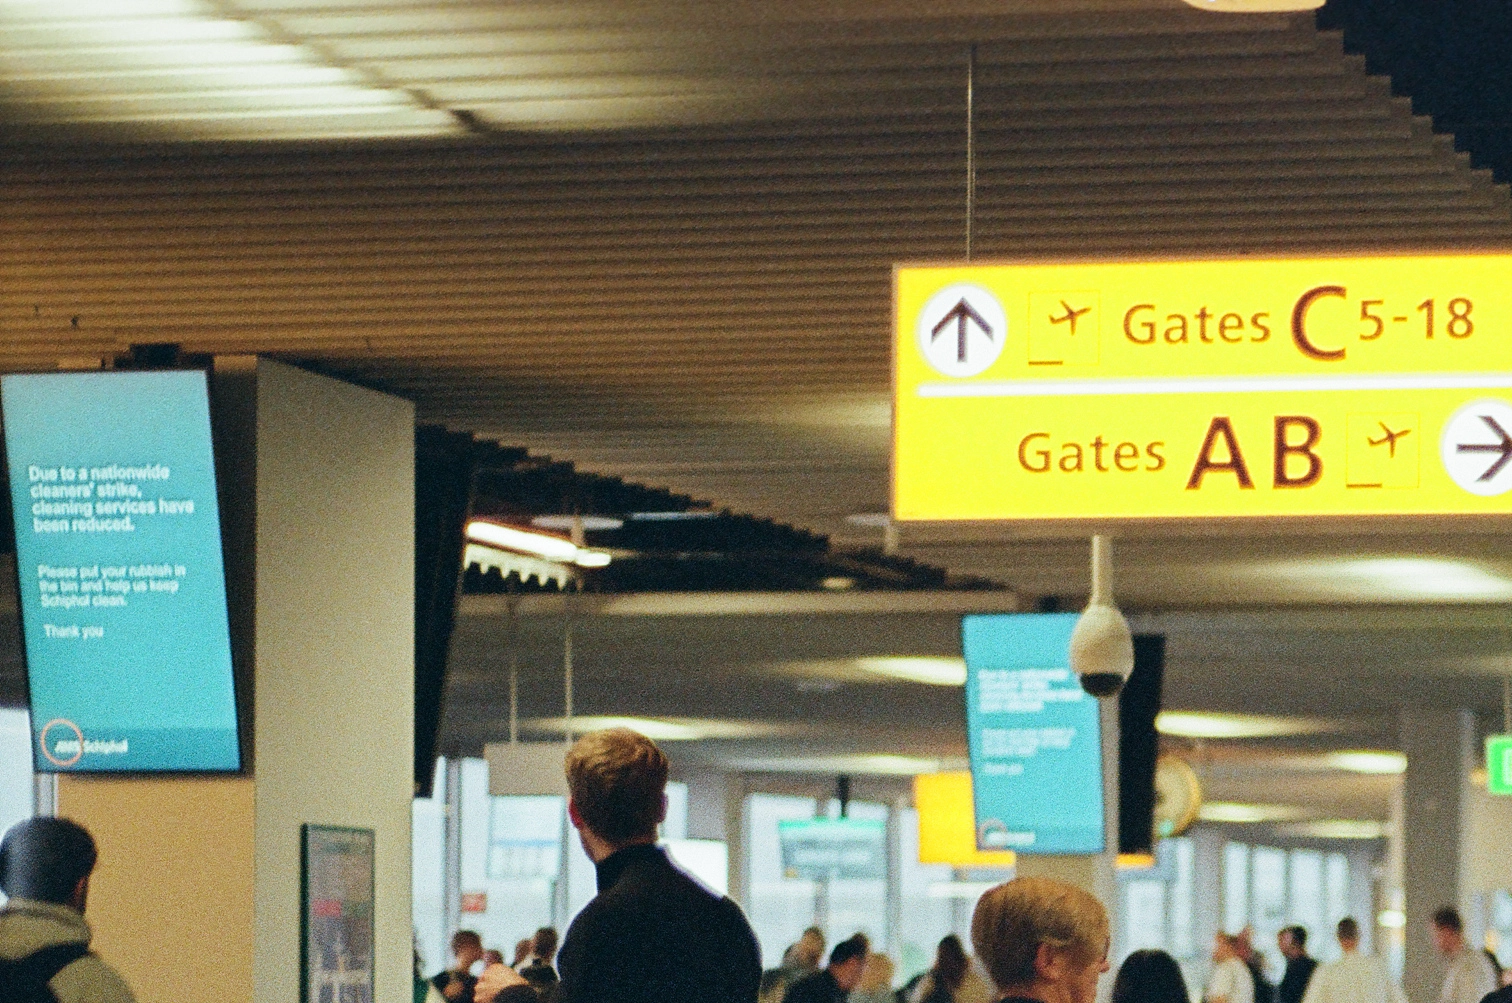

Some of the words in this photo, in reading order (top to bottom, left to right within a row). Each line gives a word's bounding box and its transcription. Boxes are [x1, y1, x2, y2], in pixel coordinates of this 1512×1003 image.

[1123, 303, 1271, 346] Gates
[1290, 284, 1348, 362] C
[1358, 297, 1475, 342] 5-18
[1017, 432, 1167, 473] Gates
[29, 465, 58, 481] Due
[60, 466, 76, 481] to
[78, 467, 88, 481] a
[90, 464, 170, 481] nationwide
[32, 499, 93, 517] cleaning
[95, 499, 156, 514] services
[158, 497, 195, 514] have
[33, 517, 69, 533] been
[100, 566, 127, 579] your
[43, 623, 80, 638] Thank
[81, 626, 104, 640] you
